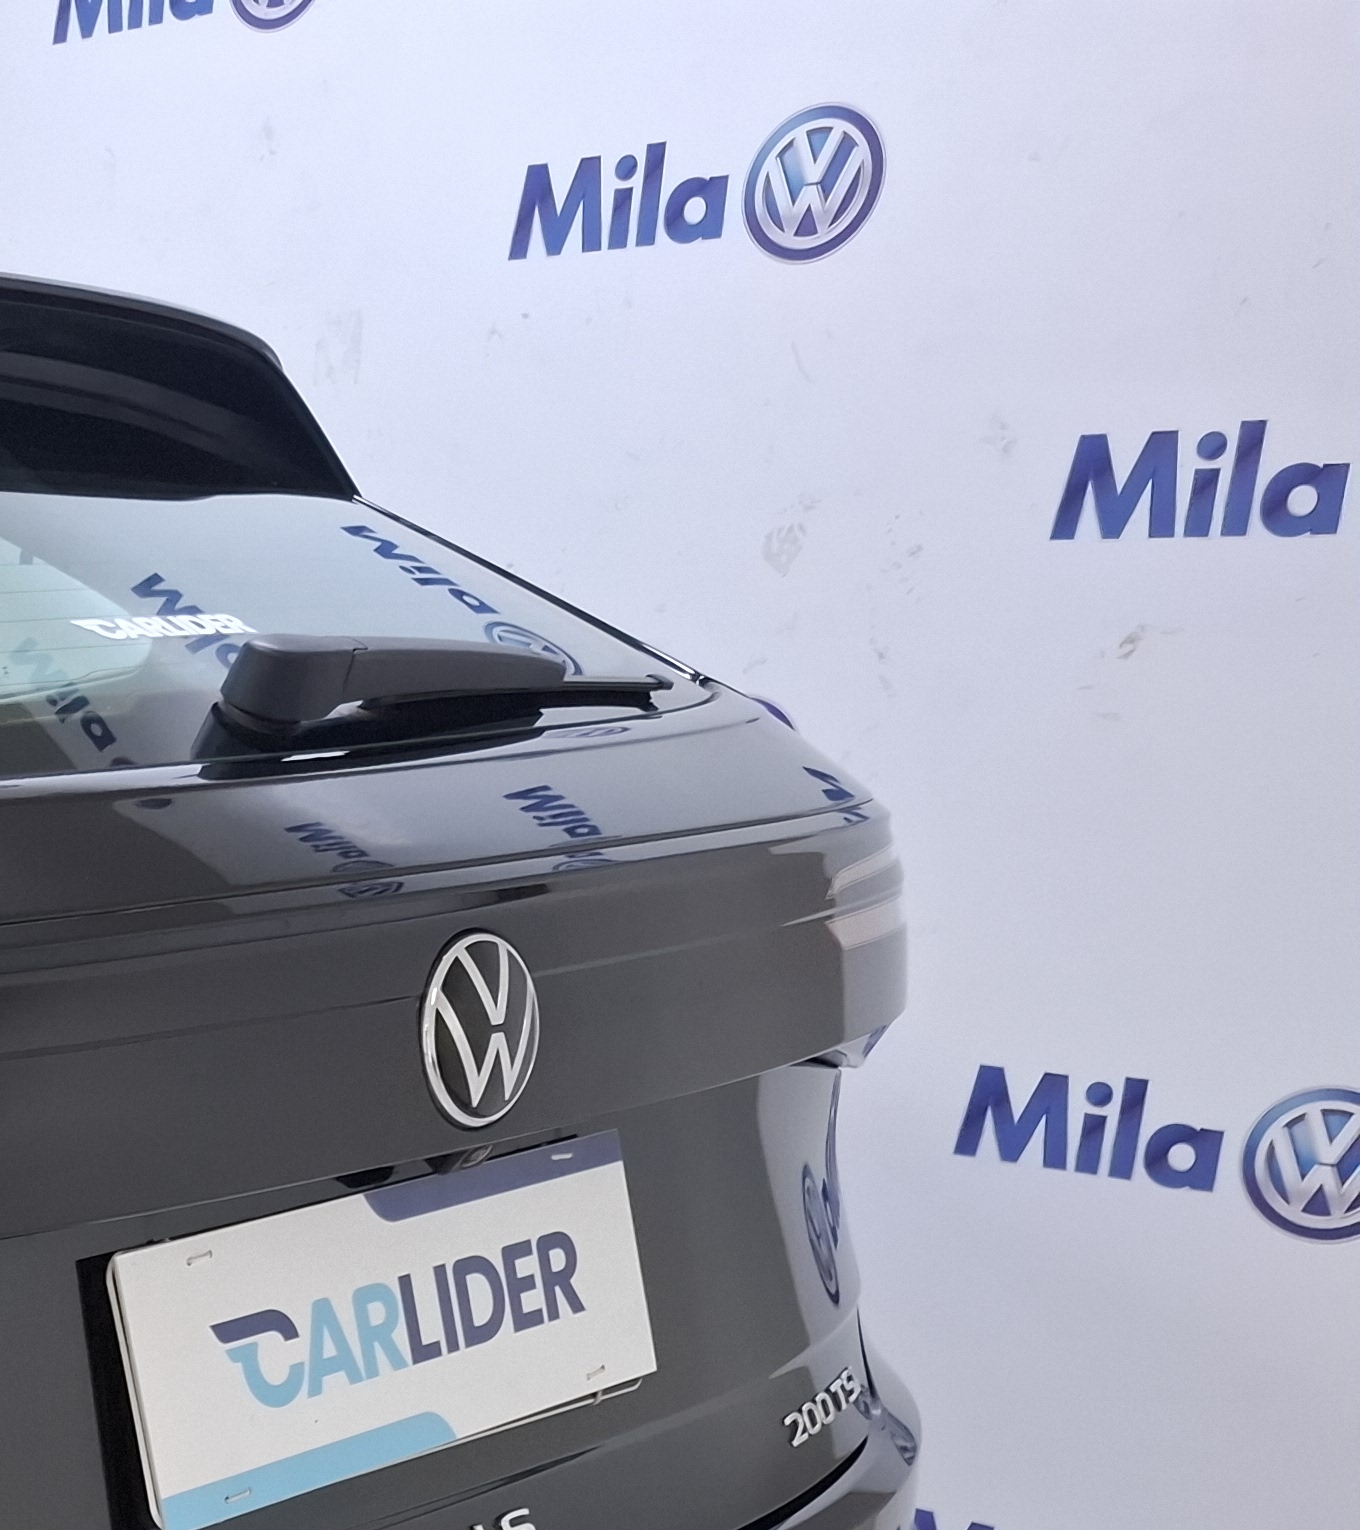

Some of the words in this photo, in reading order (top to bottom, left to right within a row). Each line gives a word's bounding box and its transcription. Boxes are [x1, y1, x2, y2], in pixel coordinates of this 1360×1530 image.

[508, 141, 729, 261] Mila
[1048, 419, 1351, 542] Mila
[953, 1064, 1225, 1192] Mila
[209, 1230, 587, 1409] CARLIDER
